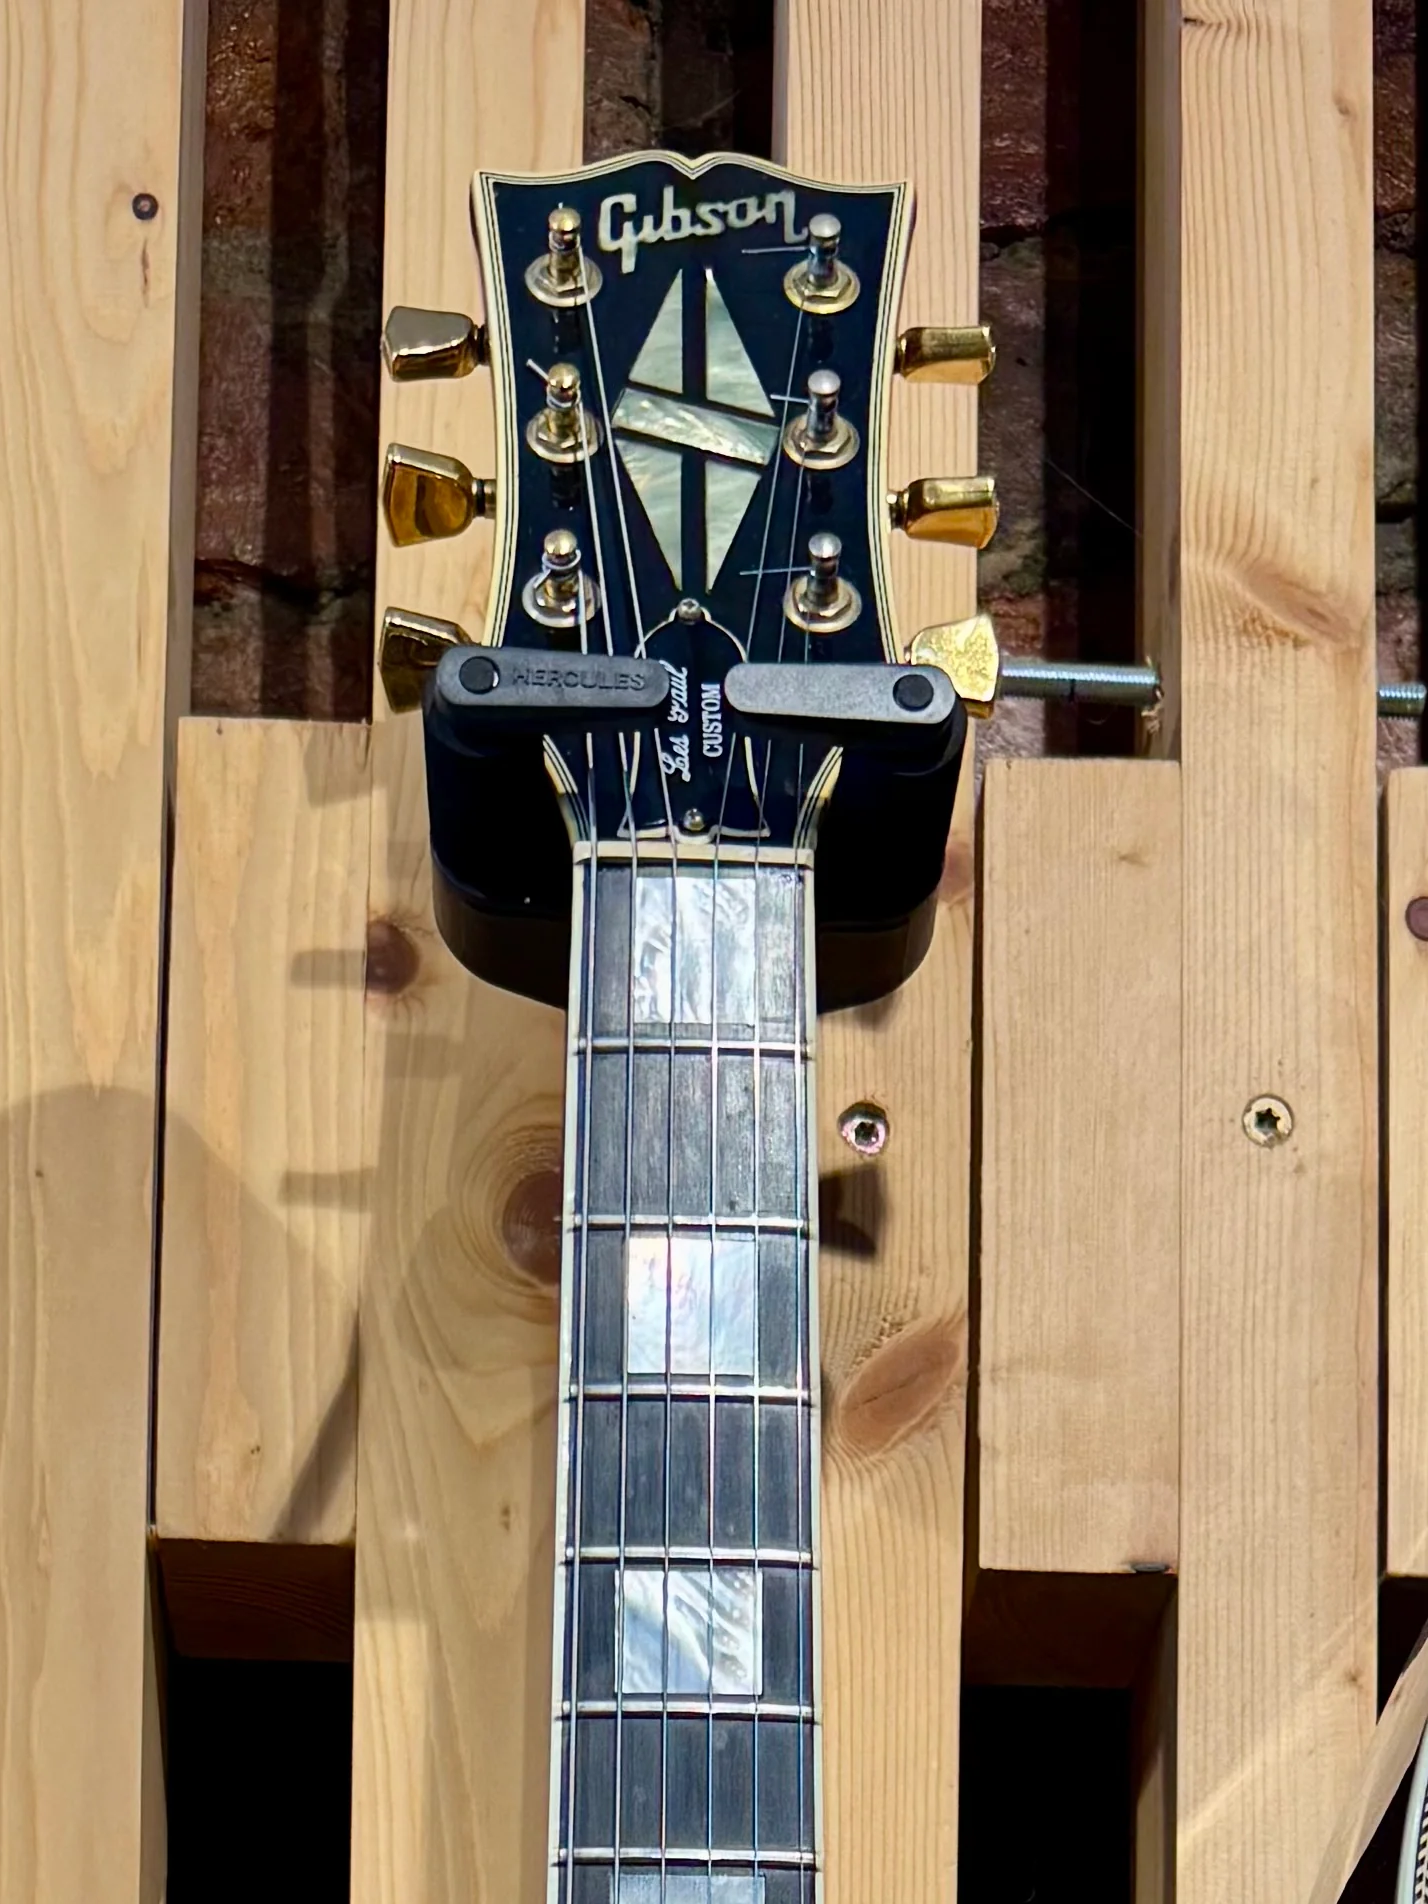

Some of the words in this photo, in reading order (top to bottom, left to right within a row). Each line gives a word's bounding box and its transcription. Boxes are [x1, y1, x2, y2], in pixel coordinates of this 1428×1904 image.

[598, 185, 809, 274] Gibson
[513, 666, 645, 691] HERCULES
[658, 660, 689, 723] Paul
[700, 683, 723, 758] CUSTOM
[661, 734, 691, 782] Les
